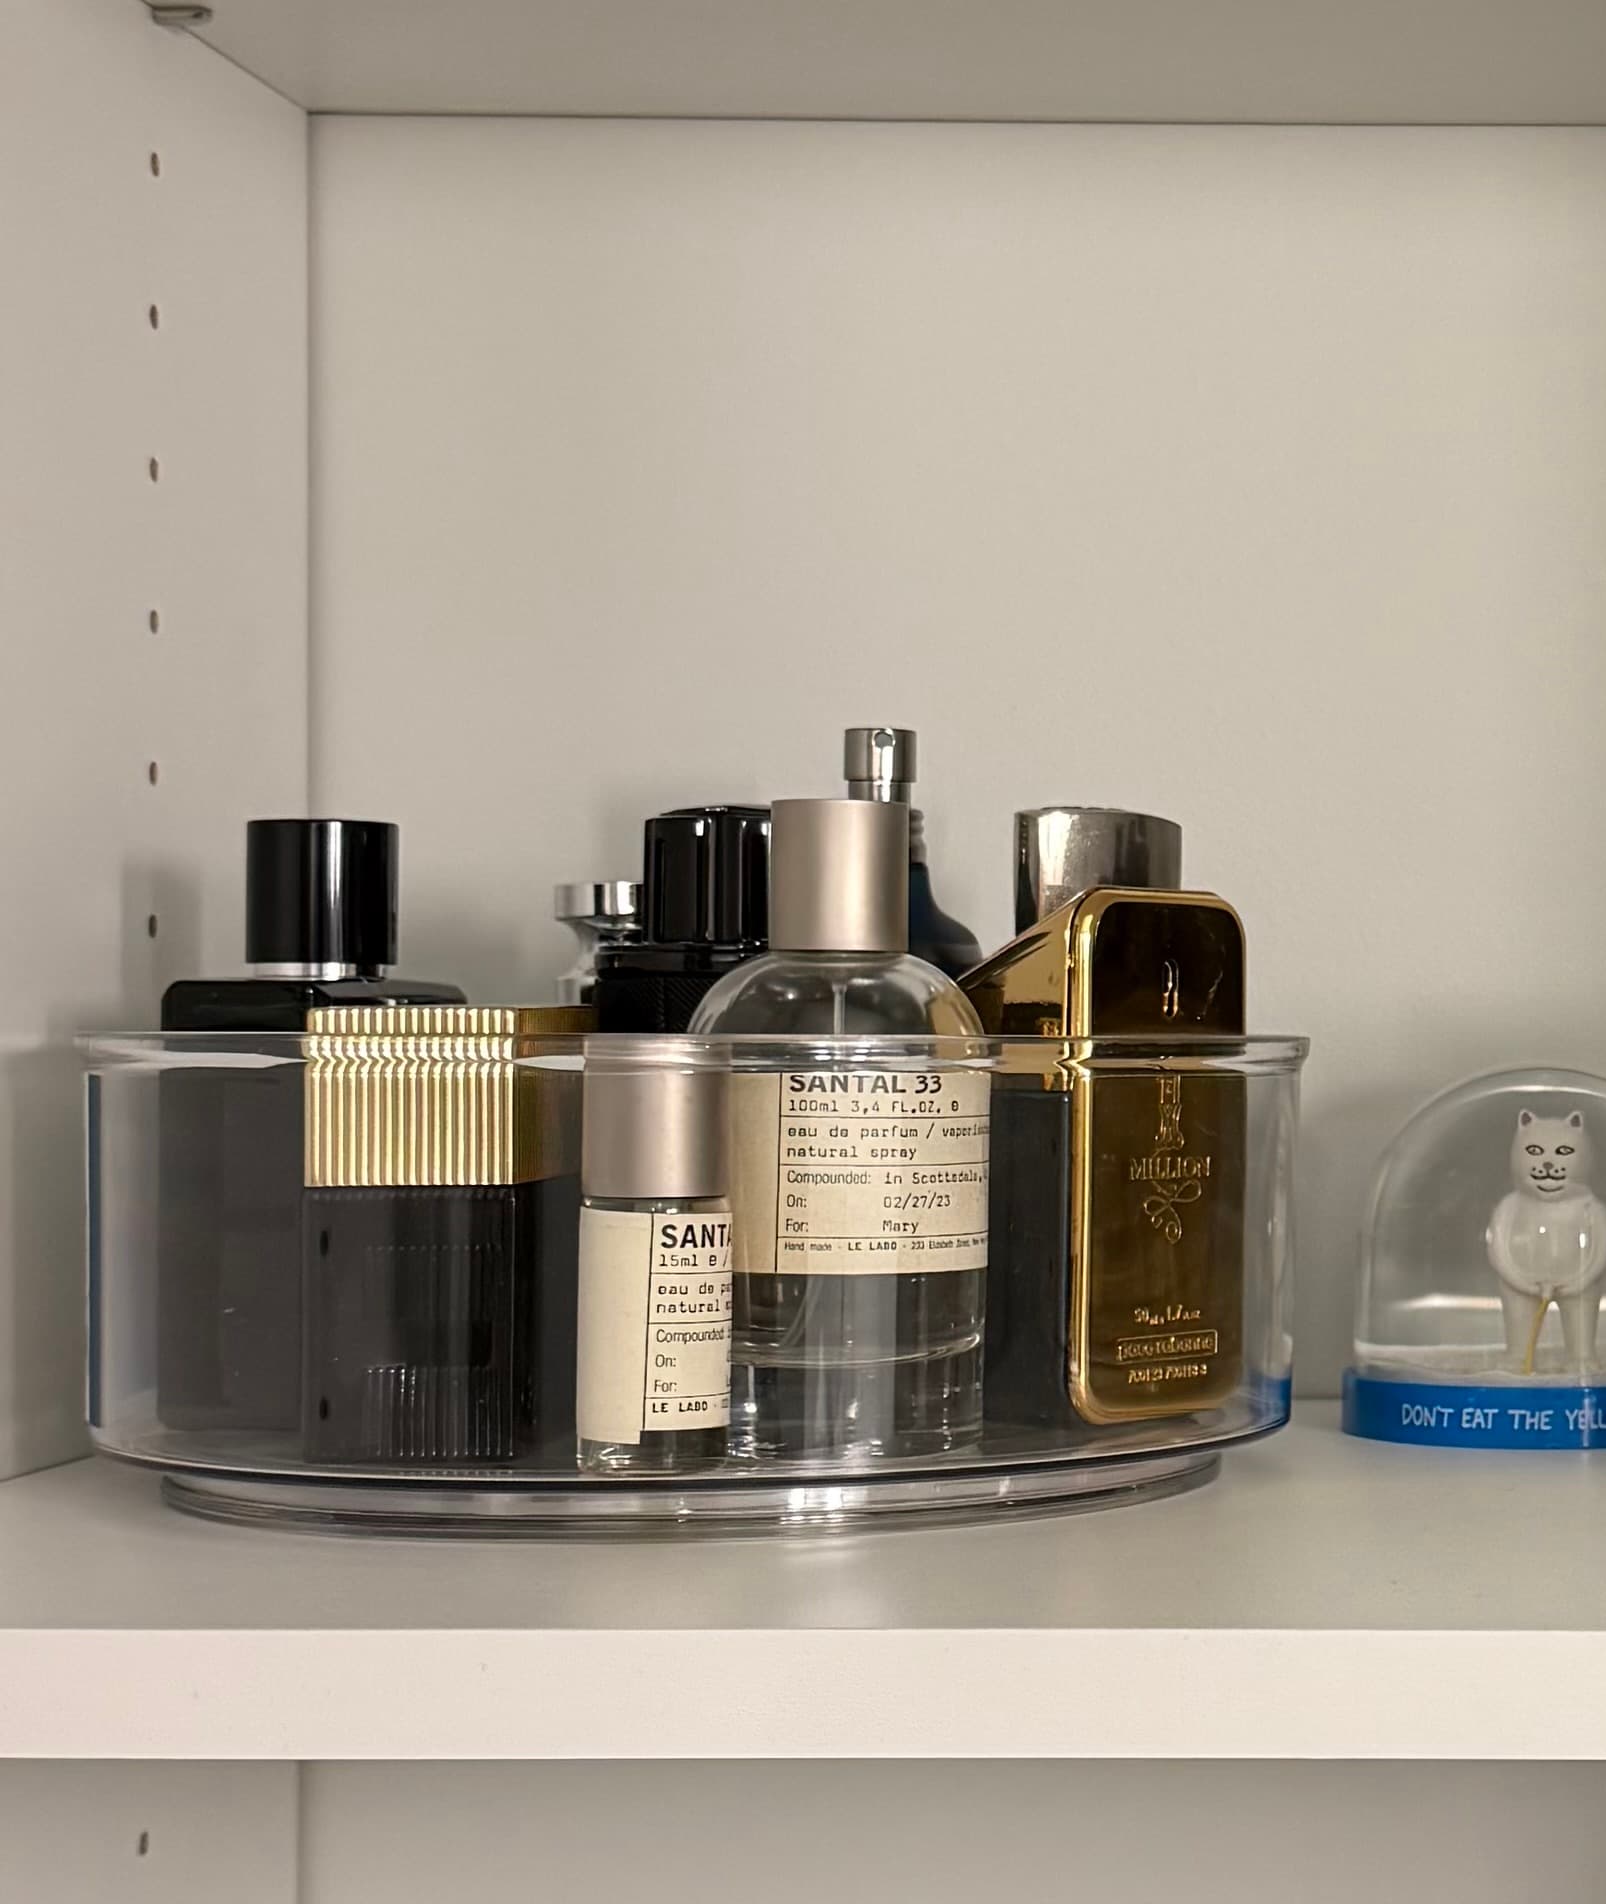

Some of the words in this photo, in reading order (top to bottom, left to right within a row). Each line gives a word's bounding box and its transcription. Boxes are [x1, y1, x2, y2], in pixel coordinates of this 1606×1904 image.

[789, 1074, 907, 1094] SANTAL
[914, 1074, 943, 1094] 33
[788, 1099, 840, 1112] 100ml
[788, 1126, 818, 1138] eau
[829, 1124, 849, 1138] de
[860, 1124, 919, 1140] parfum
[786, 1145, 859, 1158] natural
[870, 1147, 917, 1161] spray
[1129, 1156, 1212, 1181] MILLION
[786, 1170, 872, 1185] Compounded:
[884, 1171, 903, 1185] in
[786, 1193, 808, 1208] On:
[883, 1192, 951, 1211] 02/27/23
[785, 1218, 809, 1233] For:
[882, 1219, 920, 1234] Mary
[847, 1242, 862, 1251] LE
[657, 1283, 689, 1296] eau
[698, 1281, 714, 1295] de
[655, 1300, 721, 1314] natural
[654, 1353, 677, 1368] On:
[653, 1379, 678, 1393] For:
[652, 1402, 669, 1414] LE
[1401, 1403, 1455, 1428] DON'T
[1460, 1407, 1499, 1429] EAT
[1508, 1409, 1553, 1430] THE
